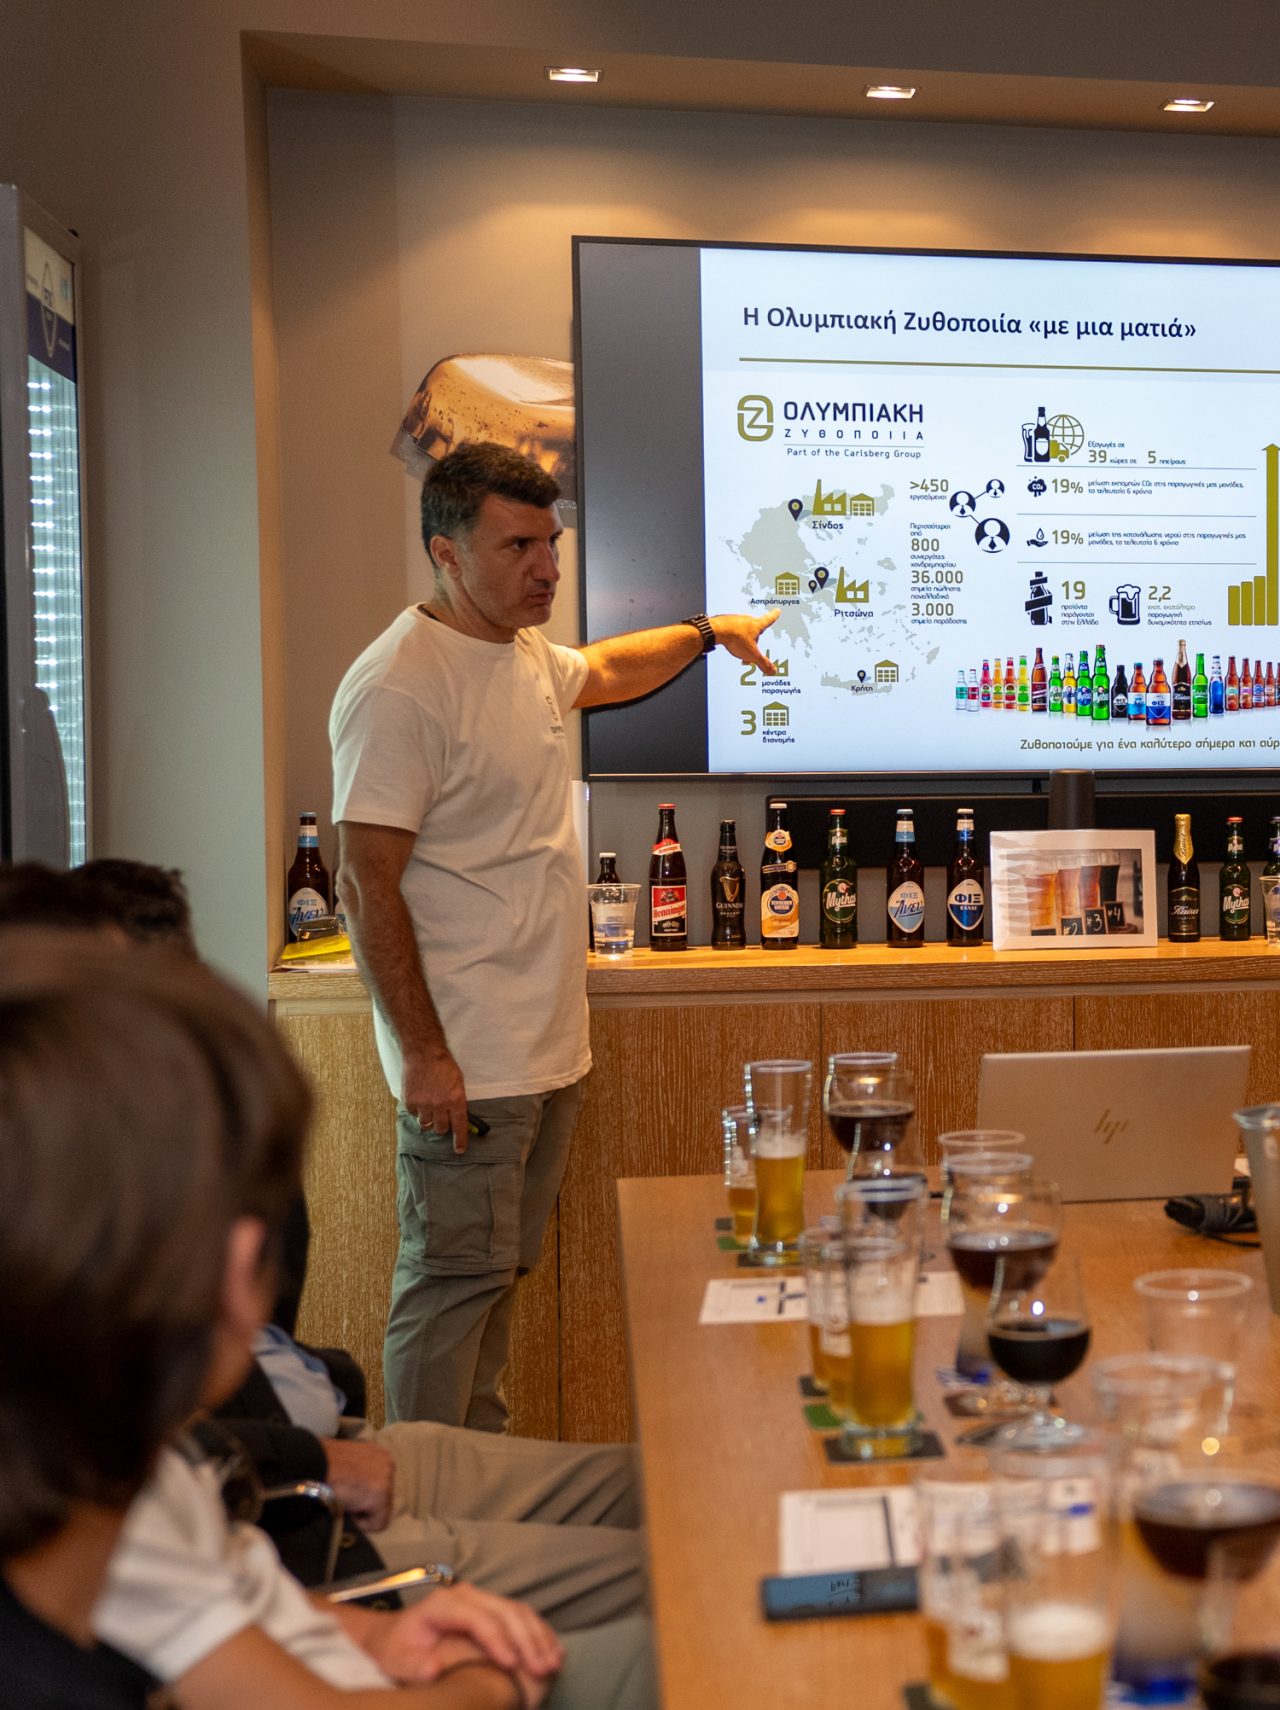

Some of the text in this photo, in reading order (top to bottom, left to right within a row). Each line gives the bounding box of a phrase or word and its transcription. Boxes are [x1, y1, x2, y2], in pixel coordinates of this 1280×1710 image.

[743, 306, 1196, 341] Η Ολυμπιακή Ζυθοποιία «με μια ματιά»
[784, 401, 924, 423] ΟΛΥΜΠΙΑΚΗ
[784, 428, 924, 440] ΖΥΘΟΠΟΙΙΑ
[1088, 441, 1116, 449] Εξαγωγές
[787, 448, 921, 460] Part of the Carlsberg Group
[1088, 449, 1107, 463] 39
[1148, 450, 1157, 464] 5
[910, 479, 949, 492] >450
[1052, 478, 1084, 494] 19%
[812, 520, 844, 529] Σίνδος
[1052, 529, 1084, 545] 19%
[911, 538, 940, 551] 800
[911, 570, 964, 584] 36.000
[1061, 580, 1086, 600] 19
[1148, 586, 1172, 602] 2,2
[750, 598, 800, 606] Ασπρόπυργος
[834, 608, 874, 618] Ριτσώνα
[911, 603, 954, 616] 3.000
[740, 661, 756, 686] 2
[851, 685, 873, 693] Κρήτη
[740, 710, 757, 736] 3
[1020, 738, 1092, 751] Ζυθοποιούμε
[1096, 739, 1114, 751] για
[1118, 738, 1136, 749] ένα
[1141, 738, 1192, 750] καλύτερο
[1195, 737, 1235, 750] σήμερα
[1239, 739, 1256, 748] και
[297, 898, 317, 906] ΦΙΞ
[900, 892, 918, 900] ΦΙΞ
[954, 893, 981, 904] ΦΙΞ
